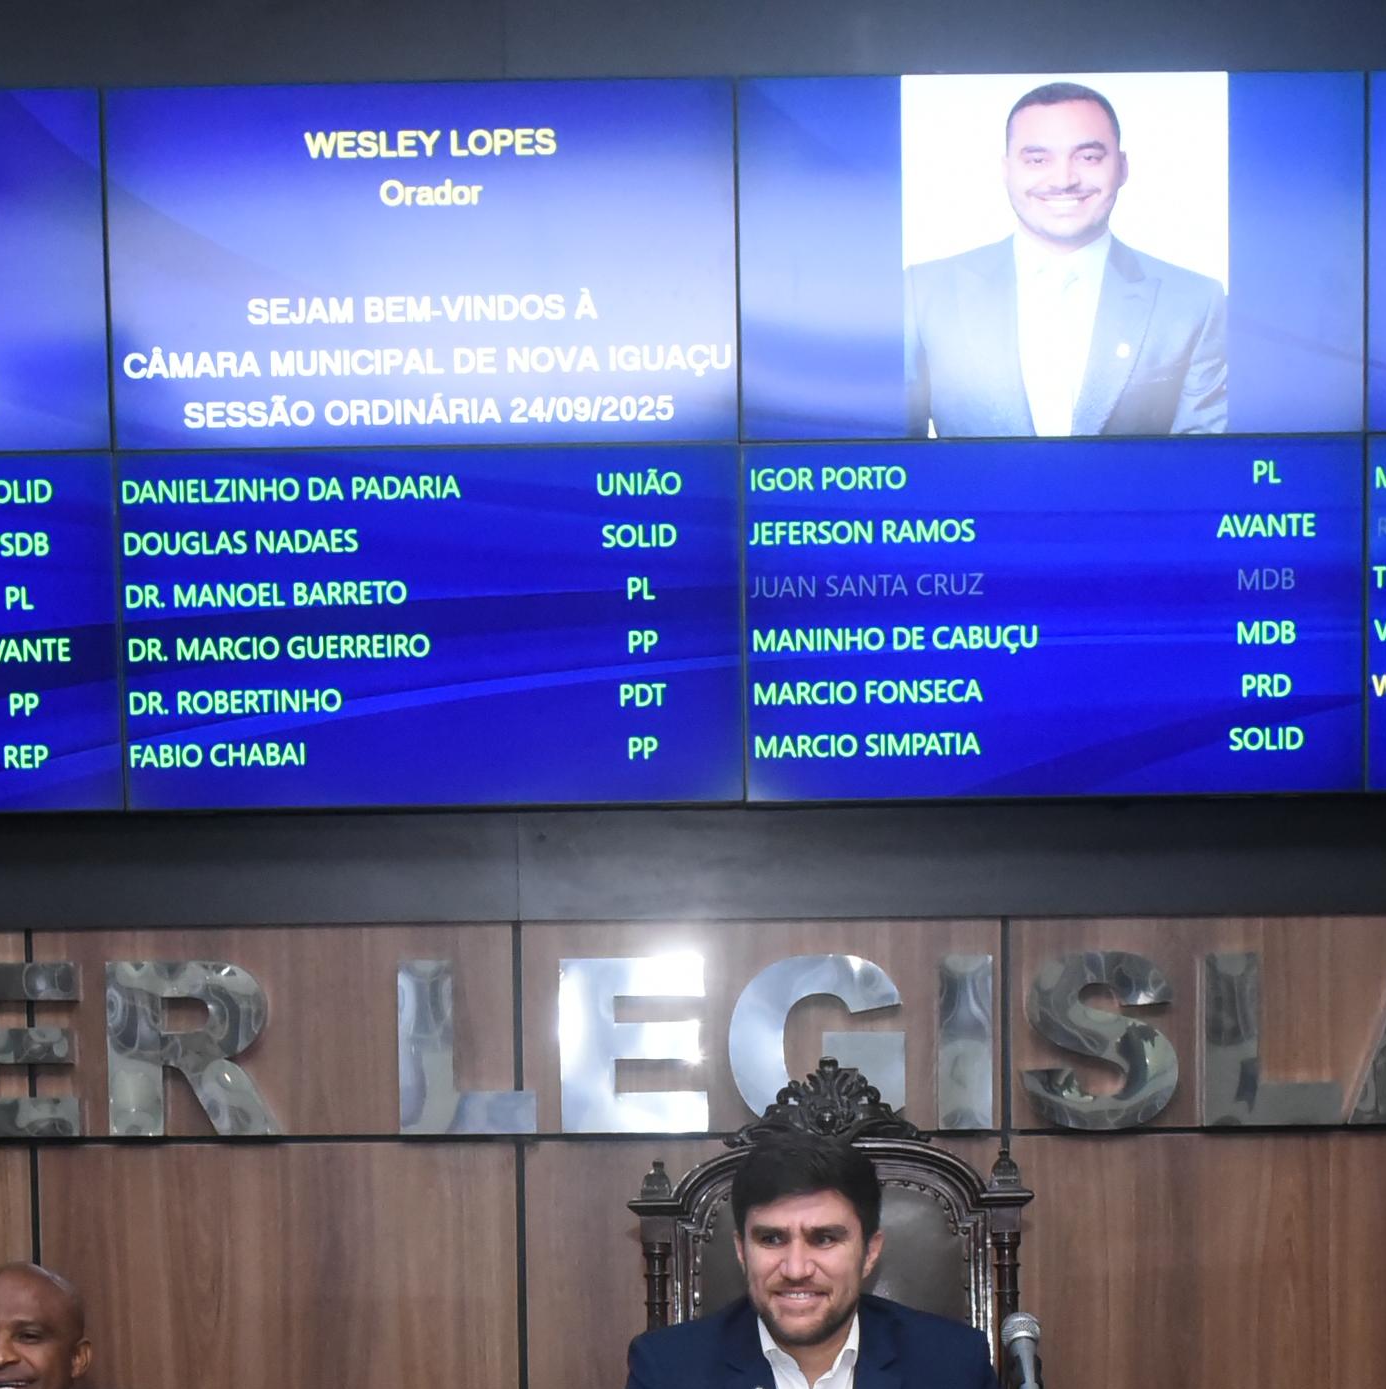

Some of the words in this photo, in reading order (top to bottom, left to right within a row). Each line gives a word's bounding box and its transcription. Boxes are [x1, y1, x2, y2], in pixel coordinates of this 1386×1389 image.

[303, 129, 442, 160] WESLEY
[449, 127, 557, 157] LOPES
[379, 178, 484, 207] Orador
[246, 296, 354, 326] SEJAM
[363, 293, 566, 324] BEM-VINDOS
[574, 287, 598, 320] À
[122, 341, 262, 382] CÂMARA
[270, 348, 445, 378] MUNICIPAL
[453, 347, 497, 374] DE
[507, 346, 600, 373] NOVA
[609, 344, 732, 378] IGUAÇU
[183, 394, 316, 430] SESSÃO
[324, 392, 502, 427] ORDINÁRIA
[509, 394, 675, 424] 24/09/2025
[596, 467, 682, 497] UNIÃO
[750, 467, 815, 492] IGOR
[821, 465, 907, 491] PORTO
[1252, 459, 1282, 485] PL
[121, 477, 301, 505] DANIELZINHO
[307, 476, 345, 502] DA
[351, 474, 462, 501] PADARIA
[601, 523, 678, 549] SOLID
[748, 520, 874, 546] JEFERSON
[881, 518, 976, 544] RAMOS
[1216, 512, 1317, 539] AVANTE
[123, 529, 248, 557] DOUGLAS
[255, 528, 359, 555] NADAES
[626, 576, 656, 601] PL
[750, 575, 816, 599] JUAN
[825, 573, 909, 598] SANTA
[916, 572, 985, 596] CRUZ
[1237, 567, 1296, 591] MDB
[4, 585, 35, 611] PL
[125, 584, 166, 609] DR.
[173, 582, 286, 609] MANOEL
[292, 579, 408, 607] BARRETO
[628, 629, 659, 654] PP
[752, 626, 886, 653] MANINHO
[892, 626, 926, 651] DE
[931, 624, 1039, 655] CABUÇU
[1236, 620, 1297, 645] MDB
[127, 637, 169, 663] DR.
[176, 635, 281, 662] MARCIO
[286, 633, 431, 660] GUERREIRO
[619, 682, 667, 708] PDT
[753, 680, 858, 706] MARCIO
[864, 678, 984, 705] FONSECA
[1241, 673, 1292, 698] PRD
[9, 692, 40, 717] PP
[128, 690, 170, 716] DR.
[176, 687, 343, 715] ROBERTINHO
[628, 735, 659, 760] PP
[754, 733, 859, 759] MARCIO
[864, 731, 982, 758] SIMPATIA
[1228, 726, 1304, 752] SOLID
[3, 744, 49, 770] REP
[129, 743, 204, 769] FABIO
[209, 742, 306, 768] CHABAI
